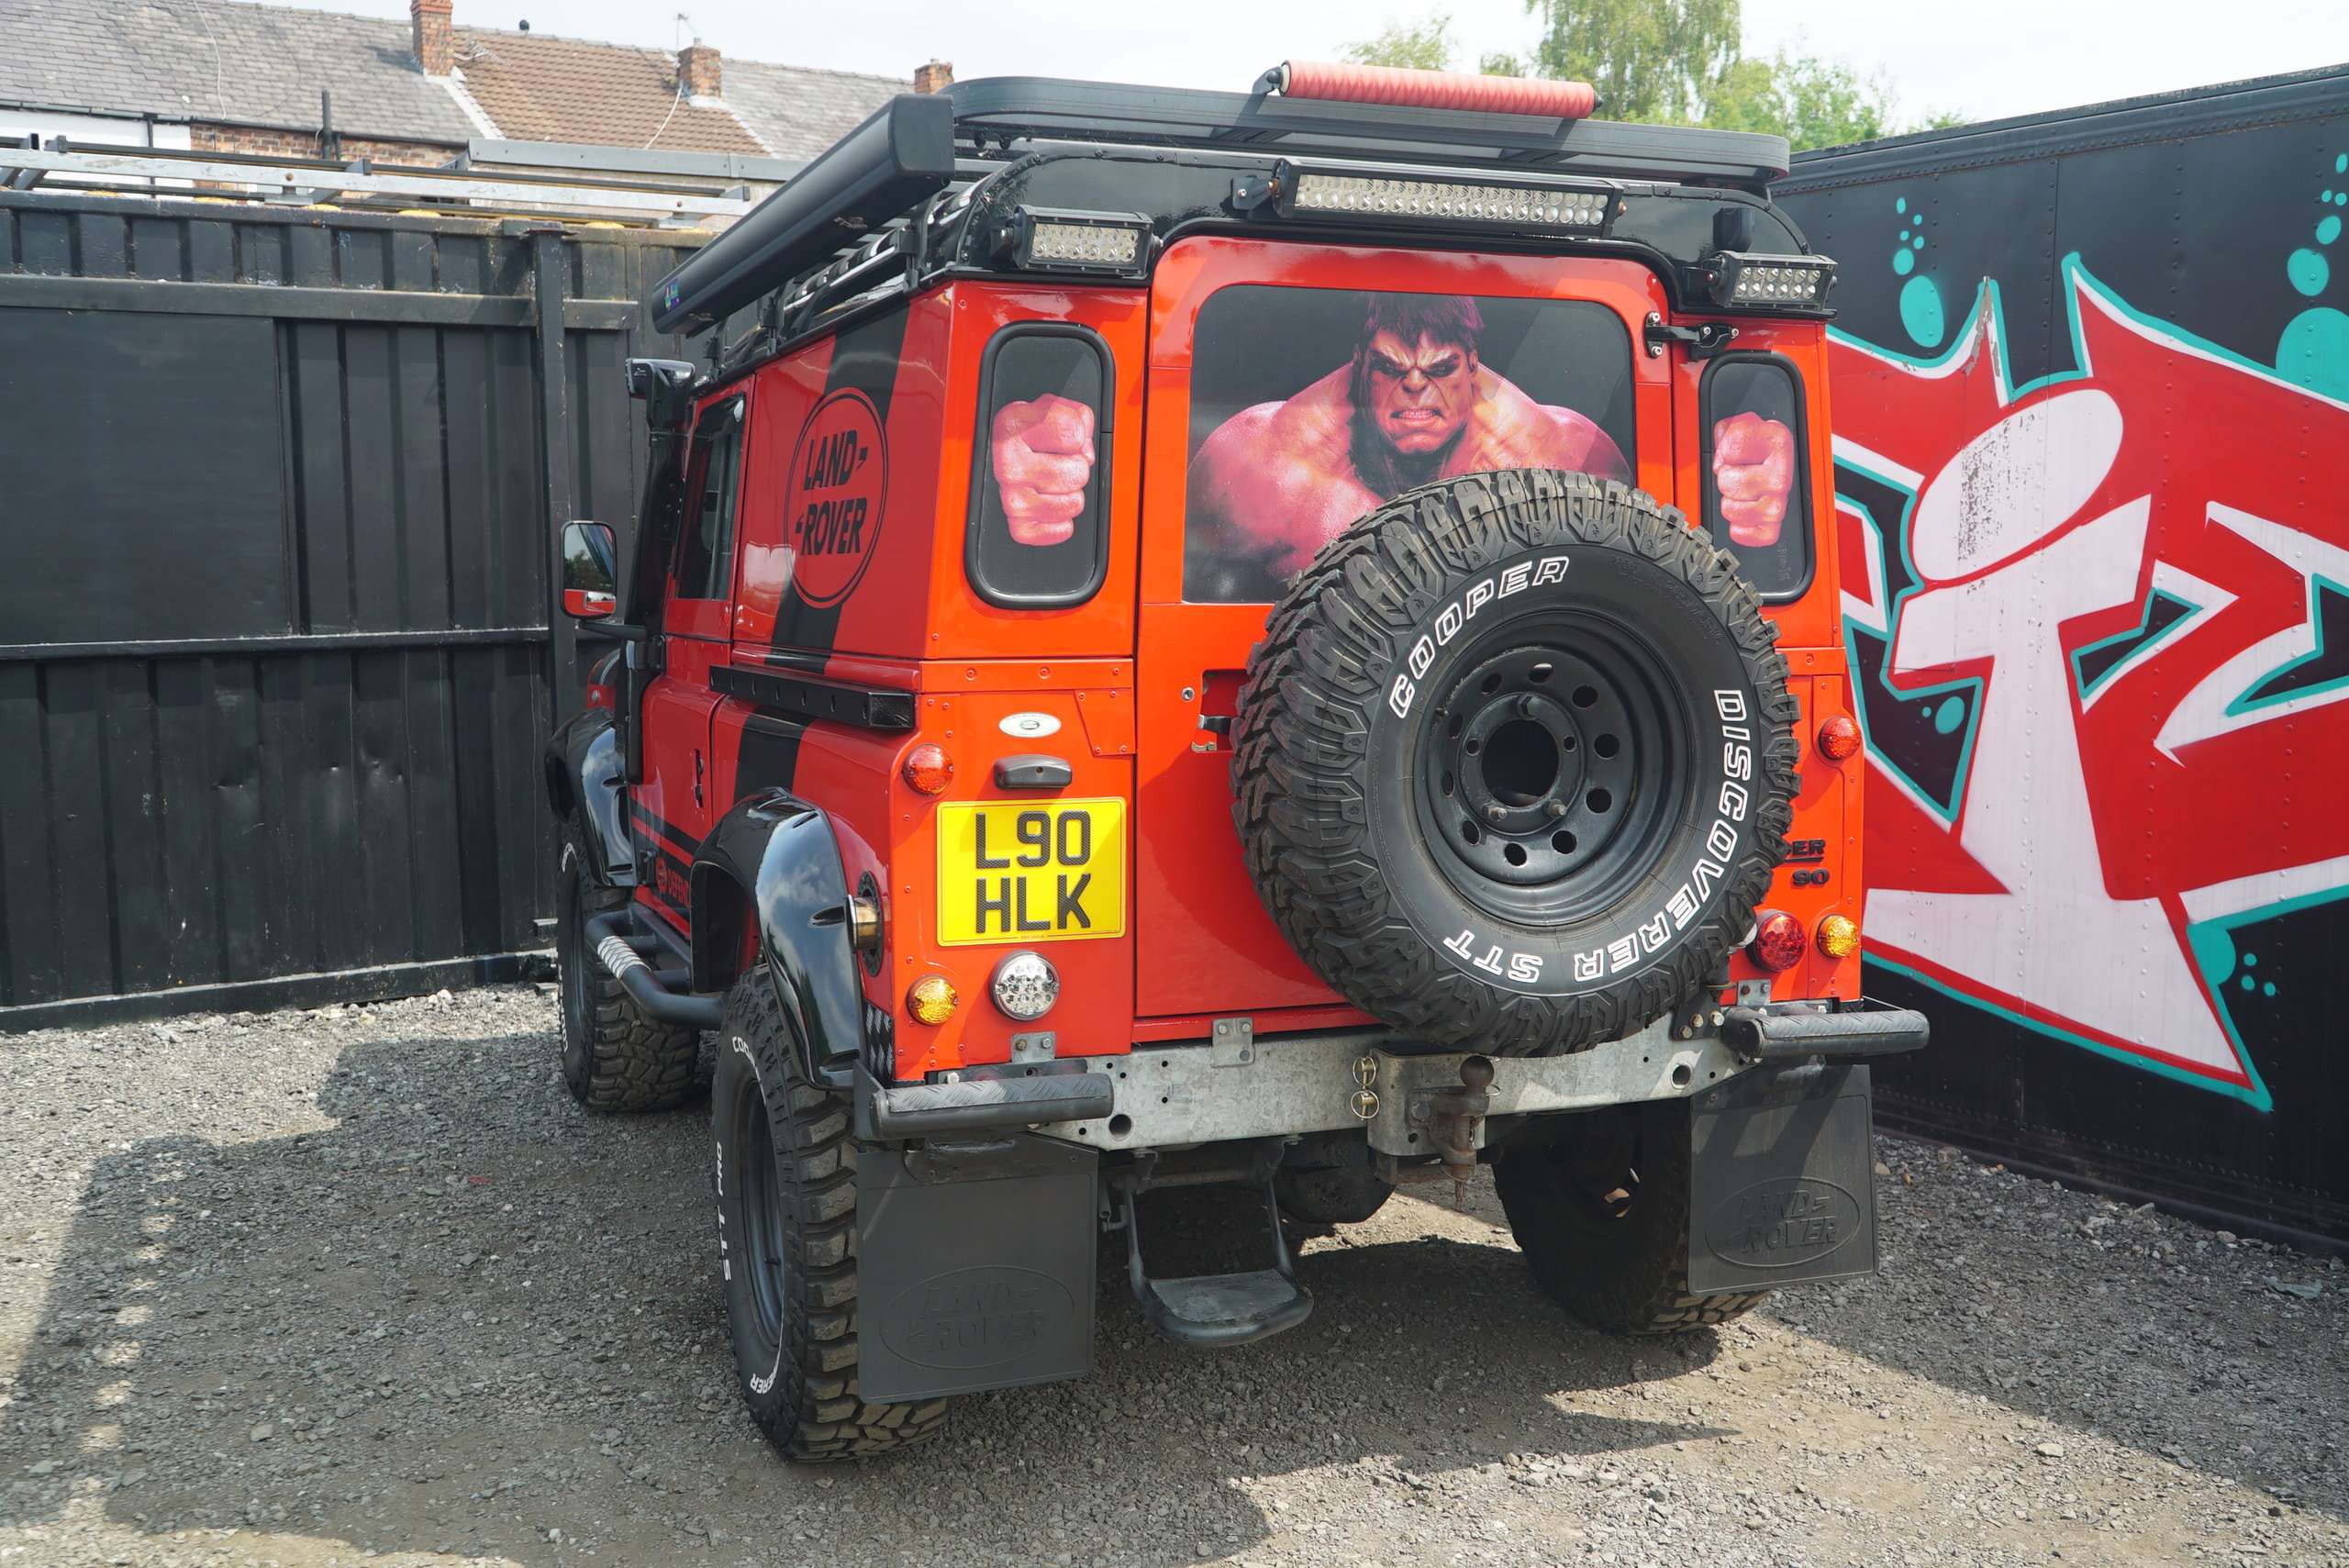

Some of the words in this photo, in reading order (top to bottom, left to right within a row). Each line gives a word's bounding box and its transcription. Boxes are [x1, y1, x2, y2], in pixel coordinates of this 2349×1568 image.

[1389, 556, 1570, 718] COOPER
[975, 810, 1092, 869] L90
[1574, 690, 1752, 983] DISCOVERER
[1792, 839, 1826, 856] ER
[975, 873, 1092, 934] HLK
[1792, 868, 1831, 886] 90
[1442, 929, 1543, 984] STT
